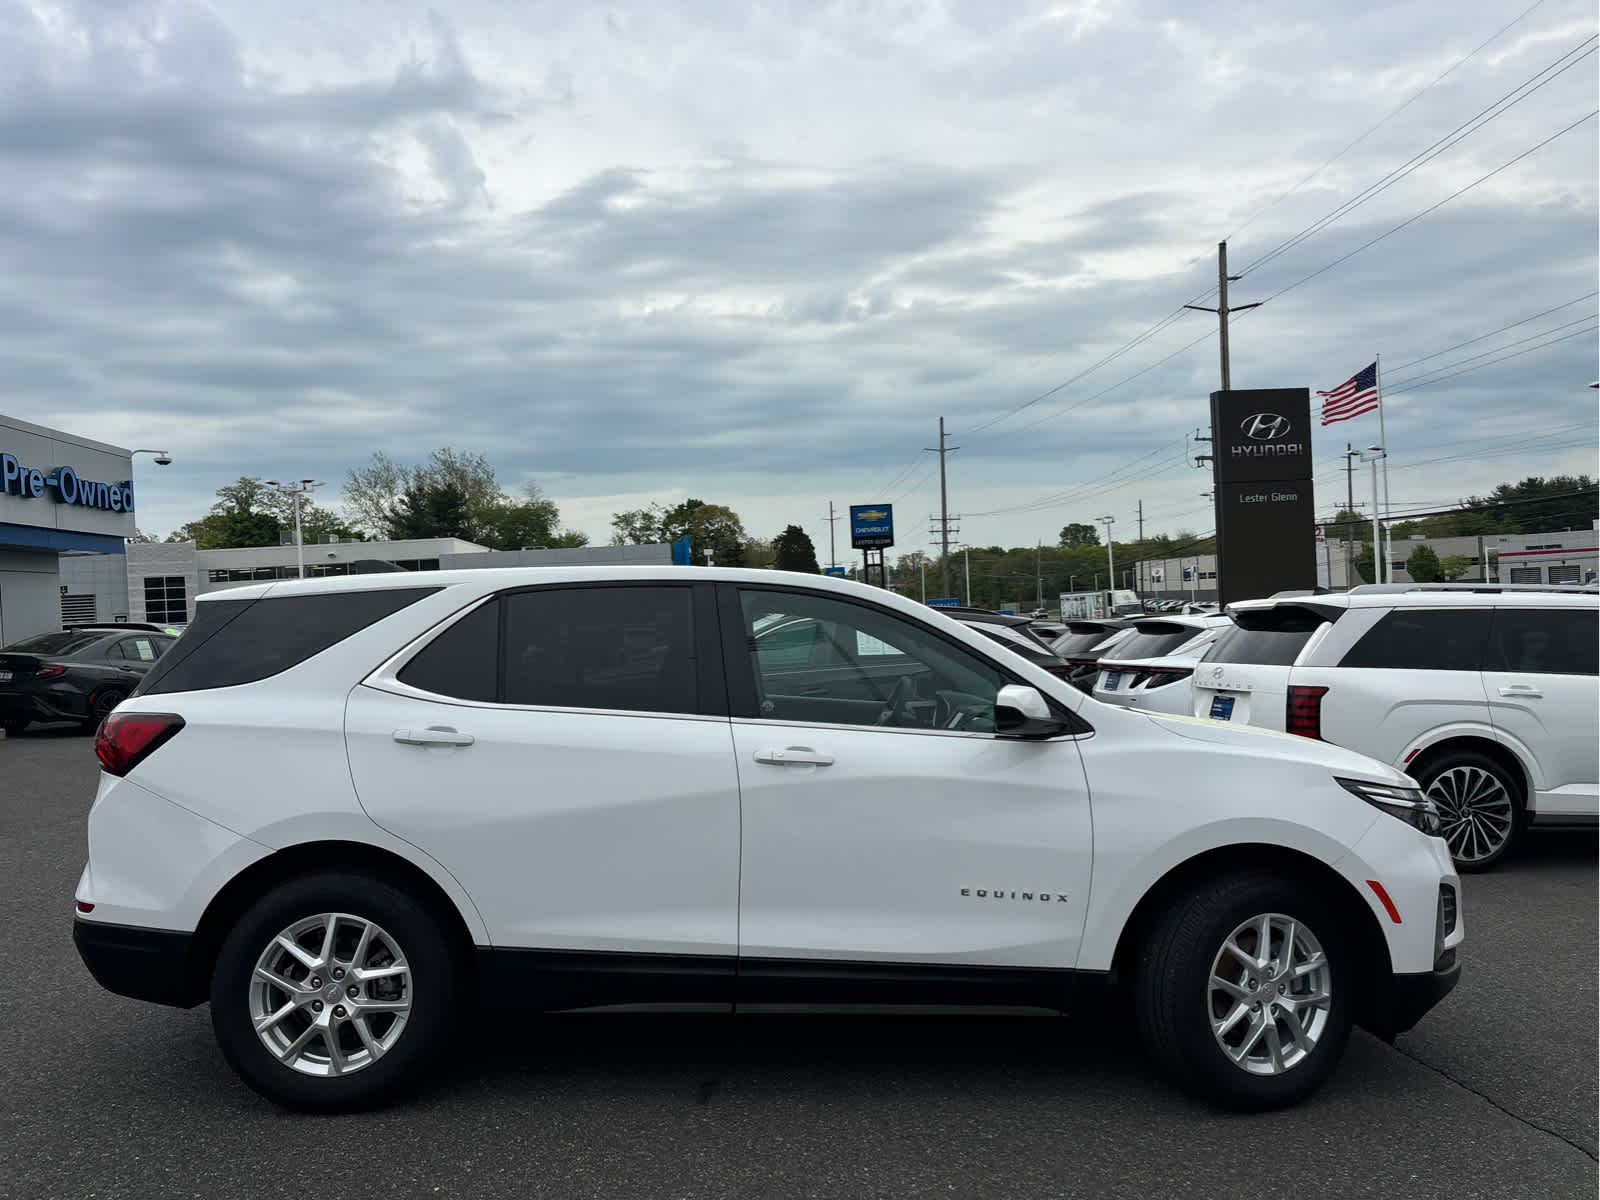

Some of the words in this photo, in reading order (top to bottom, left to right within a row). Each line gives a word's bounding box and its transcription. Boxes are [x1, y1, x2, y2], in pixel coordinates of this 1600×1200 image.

[1231, 443, 1303, 457] HYUNDAI
[0, 452, 134, 513] Pre-Owned
[1239, 493, 1268, 503] Lester
[1271, 492, 1298, 503] Glenn
[855, 526, 889, 534] CHEVROLET
[960, 888, 1069, 903] EQUINOX
